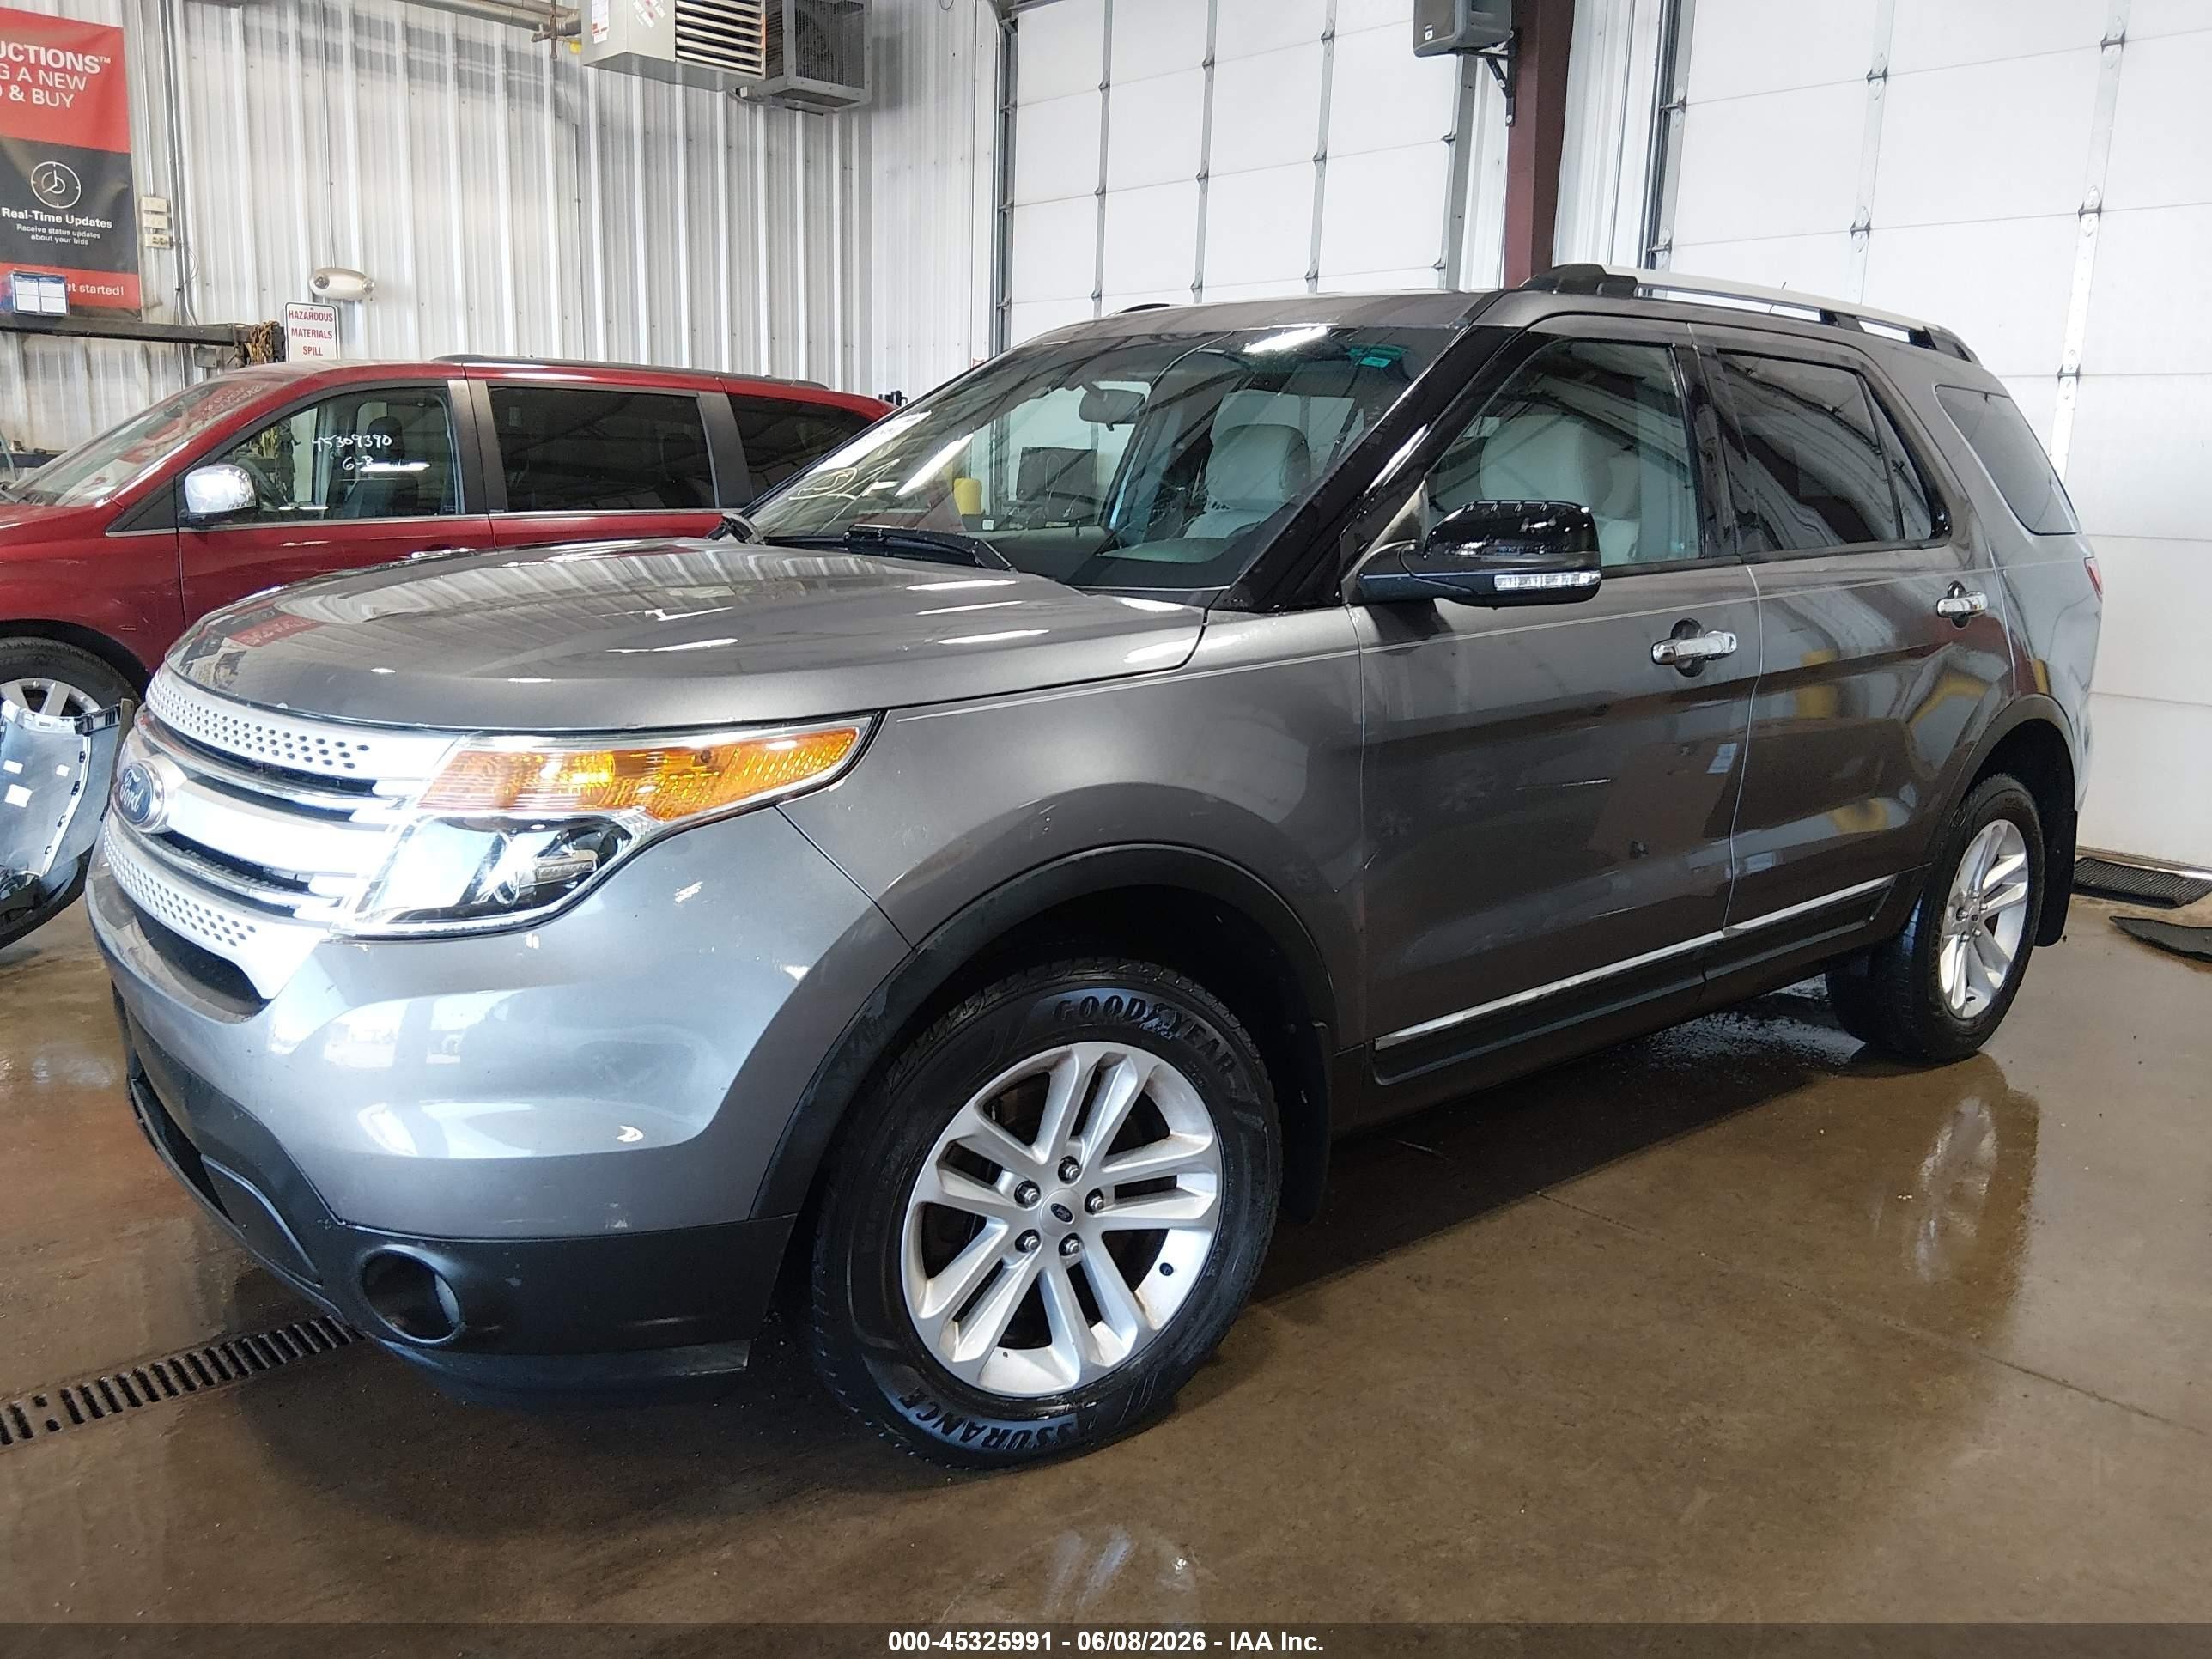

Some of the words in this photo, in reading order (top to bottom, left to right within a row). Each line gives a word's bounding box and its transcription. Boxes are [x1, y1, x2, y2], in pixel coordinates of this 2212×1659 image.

[17, 67, 33, 83] A
[39, 69, 87, 92] NEW
[9, 84, 26, 102] &
[32, 88, 74, 108] BUY
[1, 207, 63, 223] Real-Time
[65, 214, 112, 228] Updates
[16, 223, 46, 234] Receive
[72, 230, 101, 240] updates
[31, 233, 53, 242] about
[73, 237, 89, 246] bids
[79, 284, 124, 296] started!
[289, 310, 334, 323] HAZARDOUS
[291, 327, 333, 340] MATERIALS
[302, 345, 324, 356] SPILL
[312, 433, 392, 452] 45309390
[119, 769, 143, 813] Ford
[898, 1387, 1097, 1451] SSURANCE
